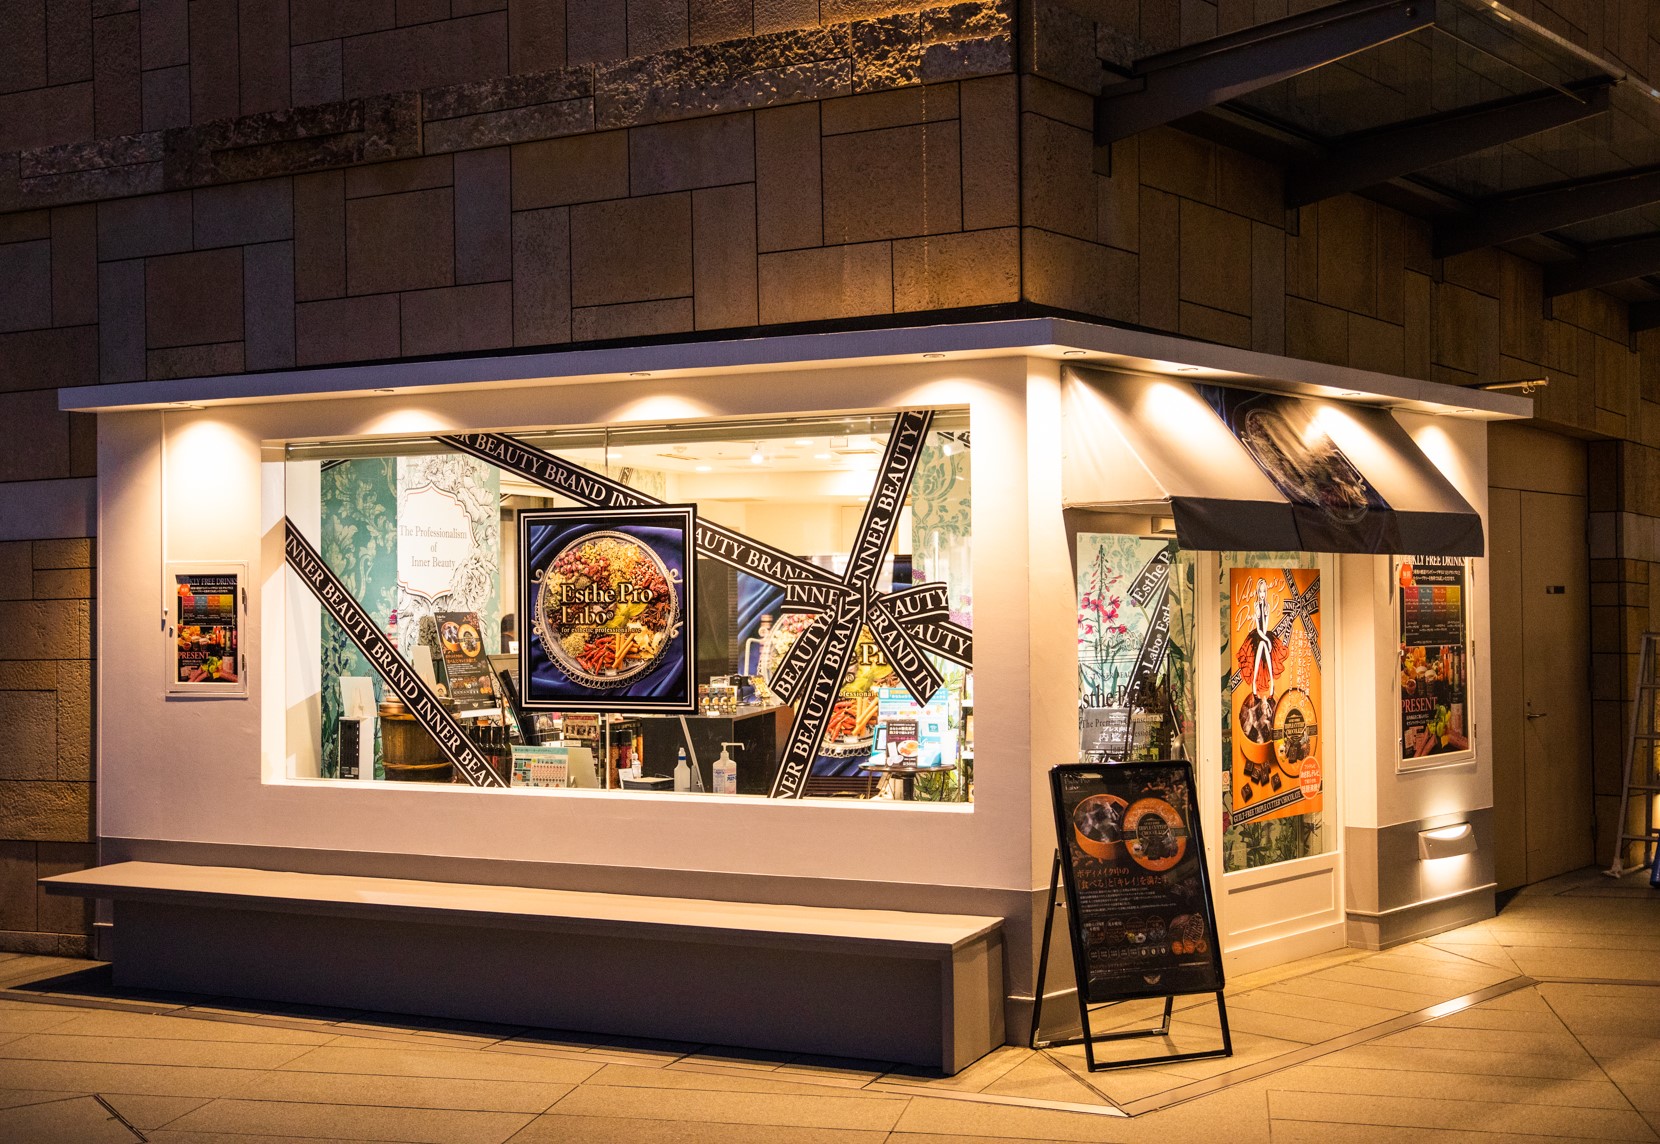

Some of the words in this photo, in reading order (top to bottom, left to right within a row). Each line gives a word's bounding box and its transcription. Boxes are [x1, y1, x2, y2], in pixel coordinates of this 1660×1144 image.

[475, 433, 544, 475] BEAUTY
[544, 463, 606, 502] BRAND
[877, 422, 919, 513] BEAUTY
[400, 525, 414, 537] The
[415, 525, 467, 539] Professionalism
[431, 542, 438, 552] of
[411, 556, 430, 567] Inner
[432, 557, 456, 571] Beauty
[561, 582, 615, 603] Esthe
[618, 582, 654, 603] Pro
[1132, 564, 1165, 603] Esthe
[178, 651, 211, 660] PRESENT
[285, 534, 324, 588] INNER
[322, 581, 375, 645] BEAUTY
[371, 642, 419, 699] BRAND
[416, 697, 461, 753] INNER
[775, 615, 829, 699] BEAUTY
[868, 606, 918, 673] BRAND
[911, 668, 939, 700] IN
[793, 672, 833, 758] BEAUTY
[1401, 696, 1438, 713] PRESENT
